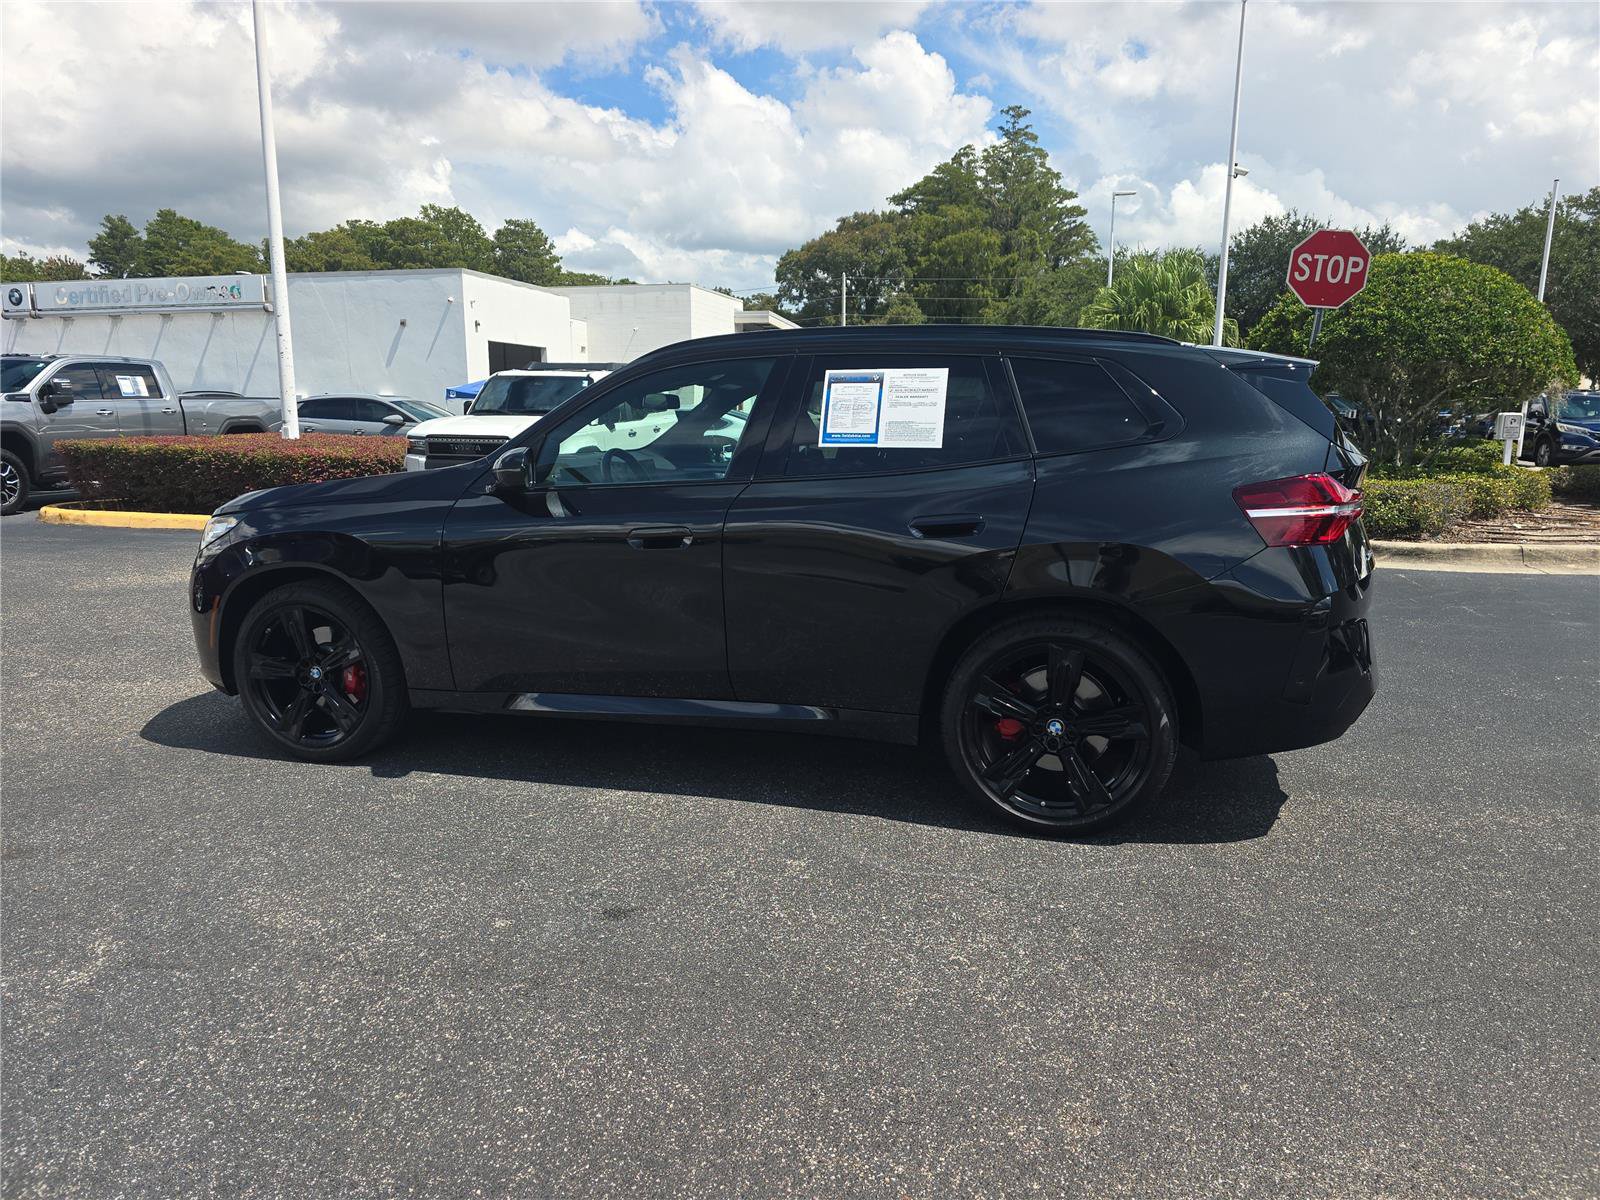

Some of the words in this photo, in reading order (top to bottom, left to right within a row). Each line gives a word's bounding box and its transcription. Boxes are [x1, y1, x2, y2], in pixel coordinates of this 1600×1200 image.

[1294, 253, 1364, 284] STOP
[55, 284, 131, 305] Certified
[449, 443, 481, 451] TOYOTA
